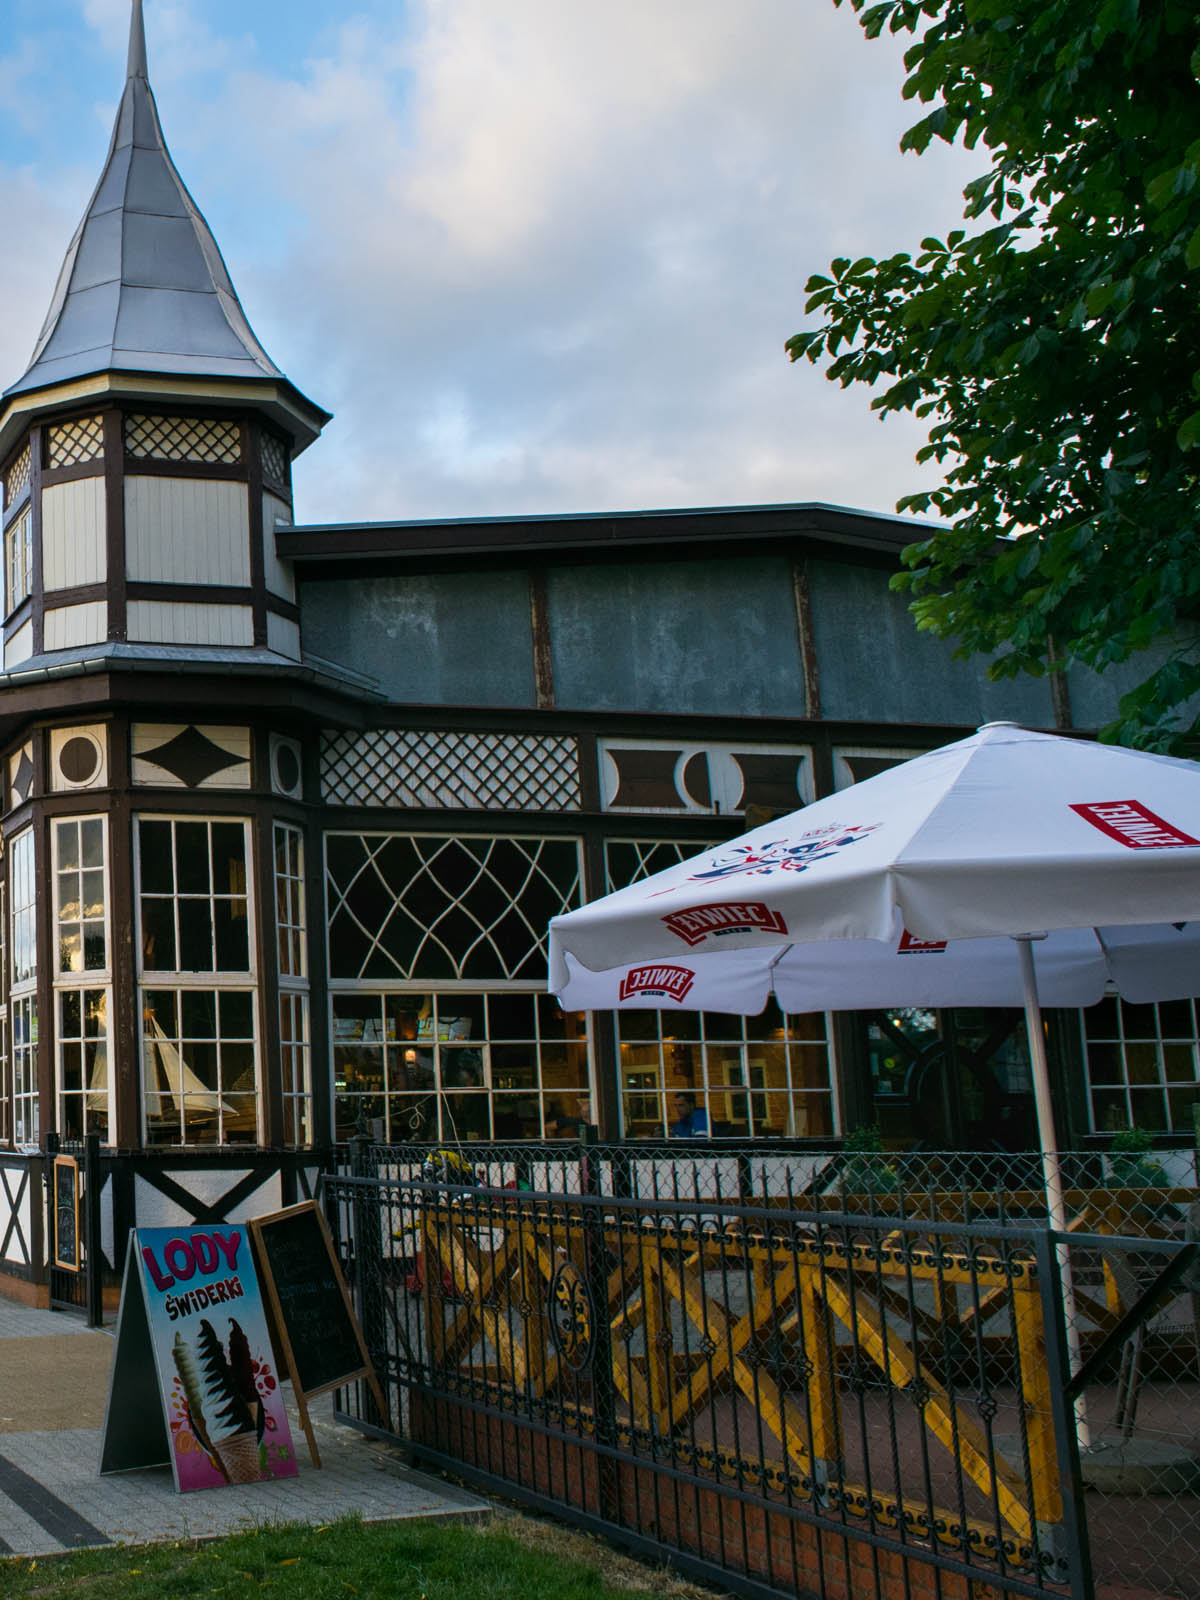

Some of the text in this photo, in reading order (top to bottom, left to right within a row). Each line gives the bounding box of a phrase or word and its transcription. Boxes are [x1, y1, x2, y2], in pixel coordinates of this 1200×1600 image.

[1087, 803, 1185, 846] ŻYWIEC
[670, 905, 767, 932] ŻYWIEC
[141, 1231, 241, 1292] LODY
